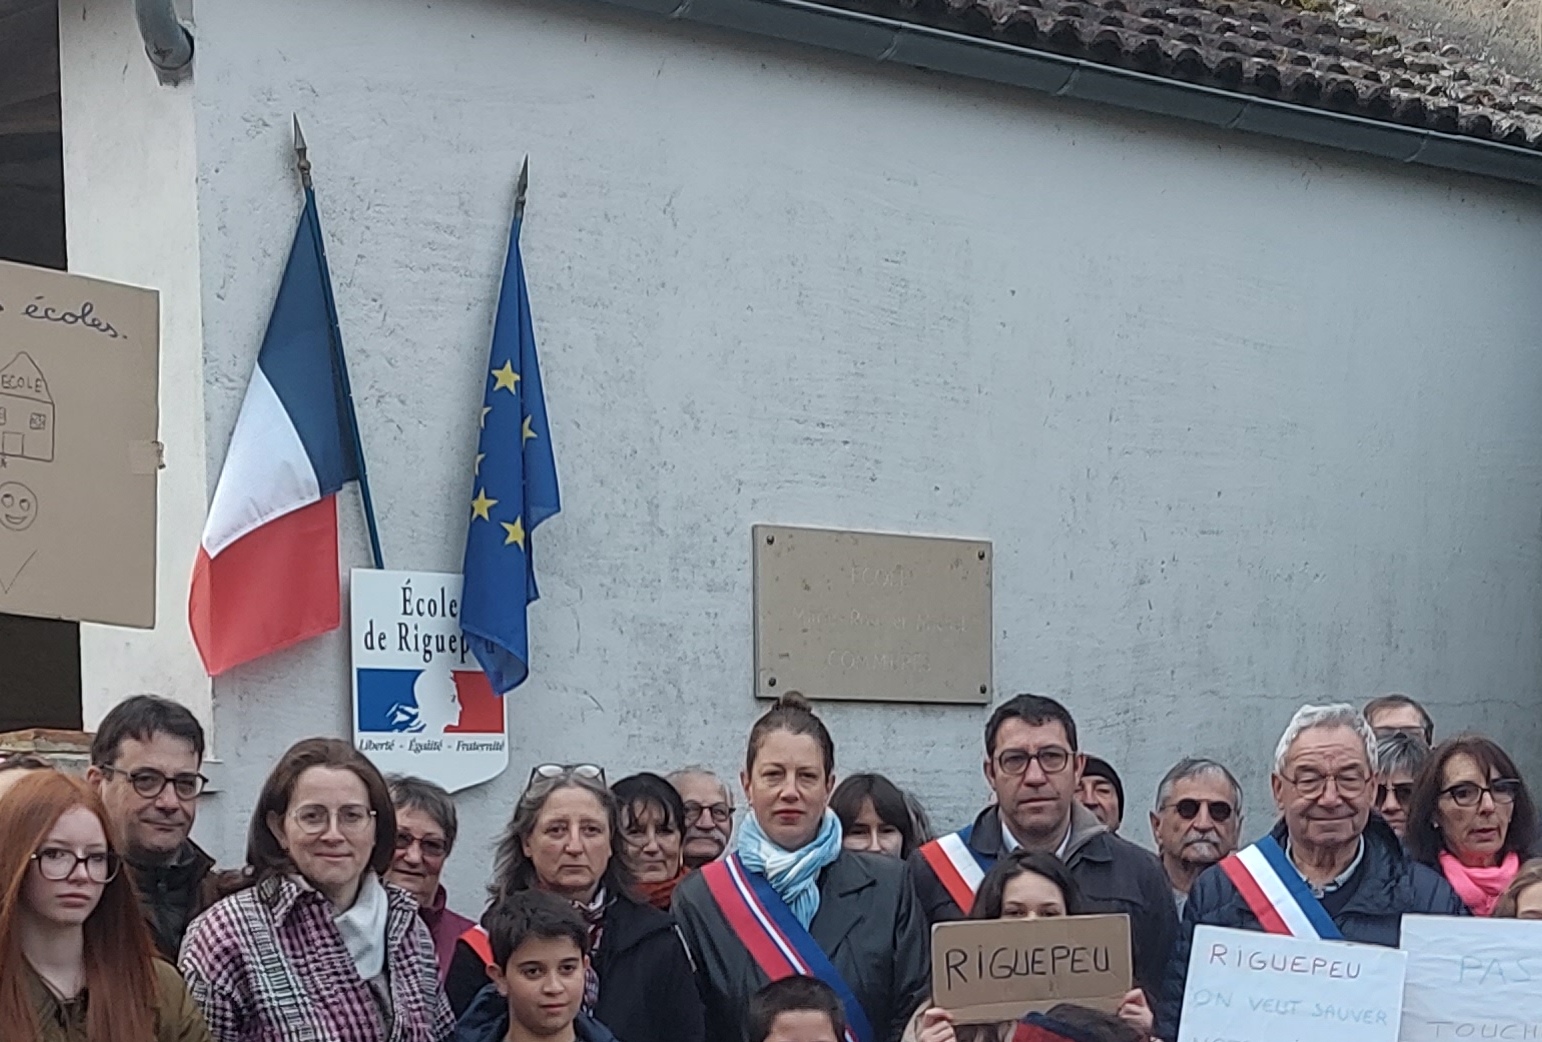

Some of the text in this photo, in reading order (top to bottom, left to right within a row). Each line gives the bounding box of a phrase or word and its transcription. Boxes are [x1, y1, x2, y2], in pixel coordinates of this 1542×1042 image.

[22, 295, 128, 341] écoles.
[0, 373, 43, 393] ECOLE
[401, 578, 458, 618] École
[364, 619, 496, 664] de Riguepu
[358, 739, 395, 751] Liberté
[408, 737, 444, 754] Égalité
[456, 739, 505, 752] Fraternité
[1459, 955, 1532, 985] PAS
[1193, 988, 1389, 1025] ON VEUT SAUVER
